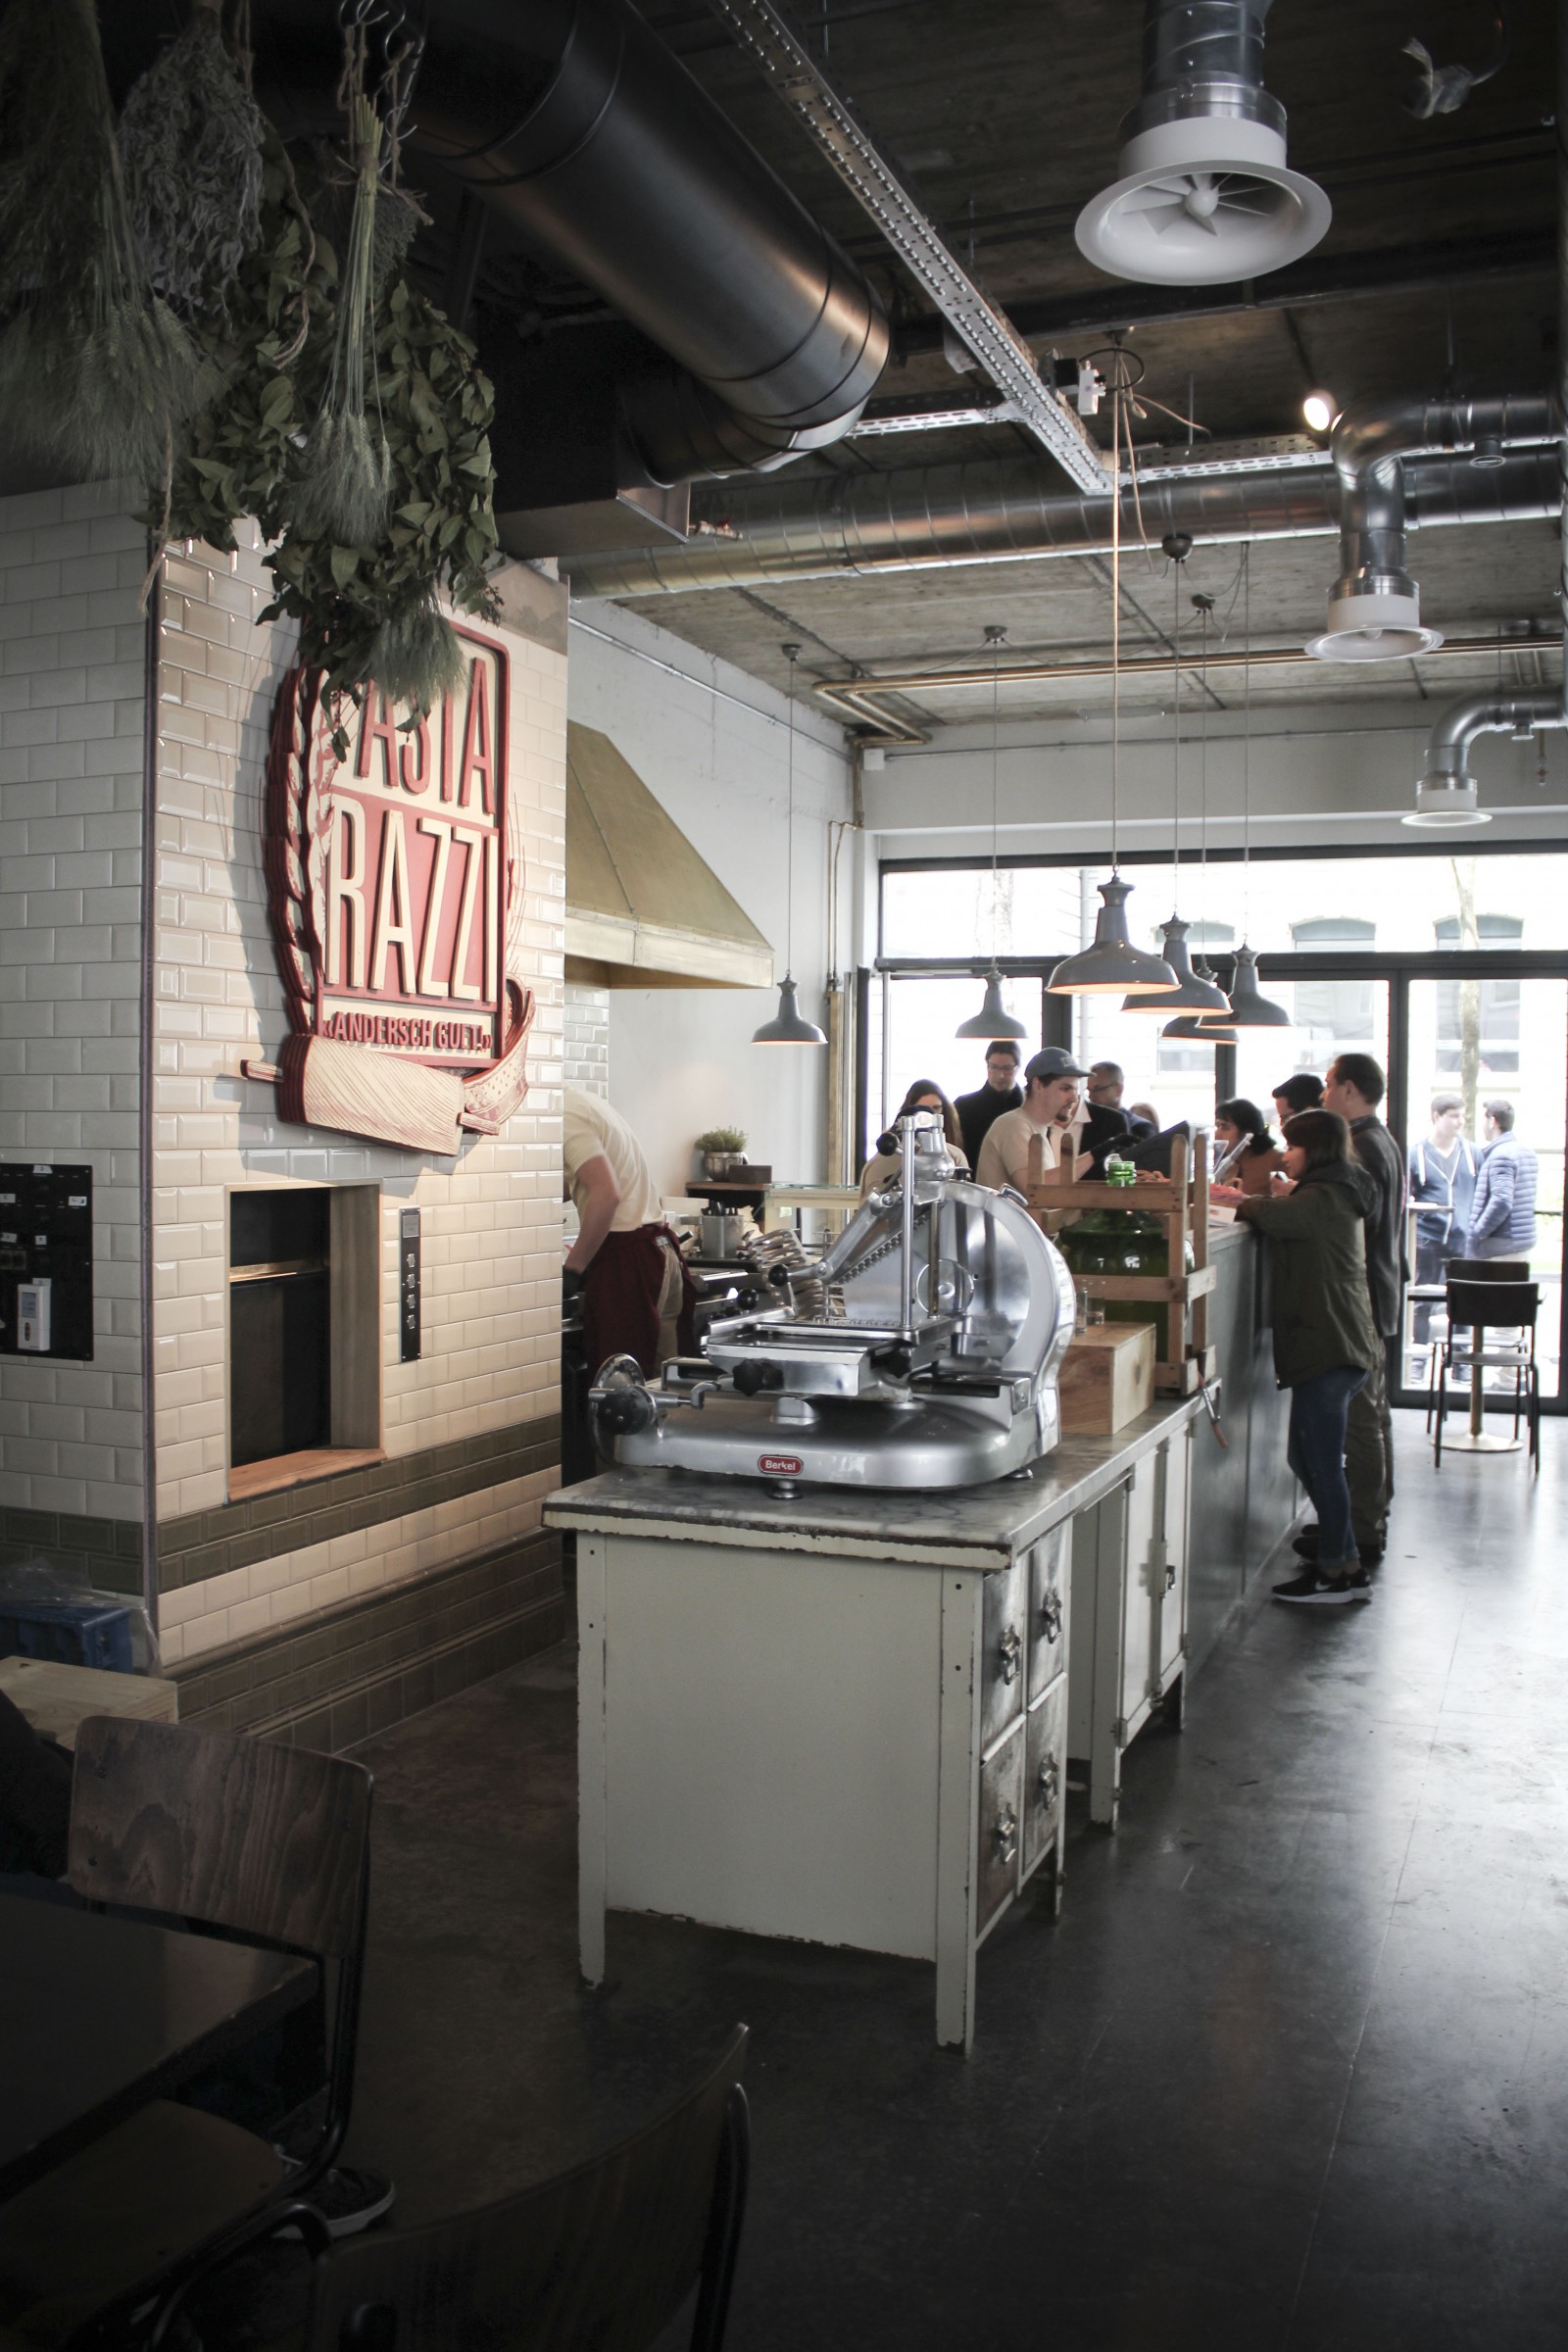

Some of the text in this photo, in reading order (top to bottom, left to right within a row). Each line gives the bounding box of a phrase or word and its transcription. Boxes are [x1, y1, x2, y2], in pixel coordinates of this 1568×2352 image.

[357, 658, 495, 814] ASTA
[324, 793, 498, 1002] RAZZI
[765, 1460, 796, 1470] Berkel
